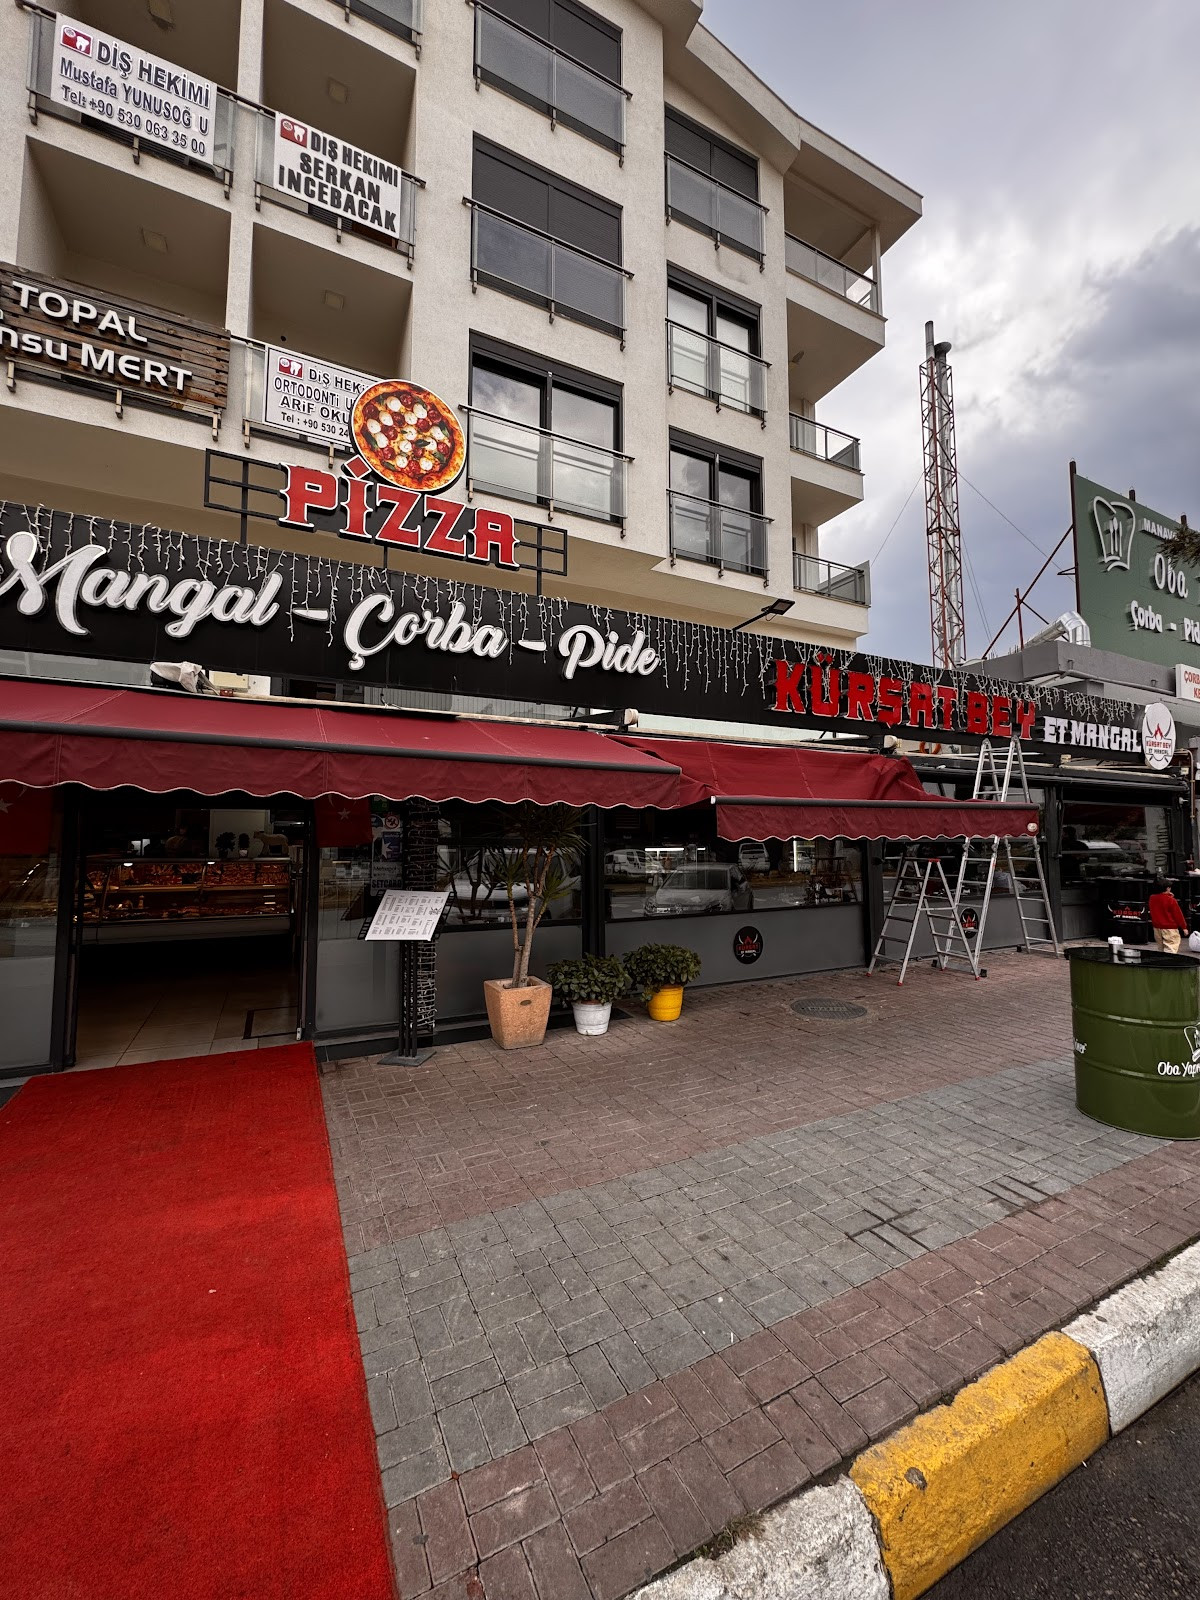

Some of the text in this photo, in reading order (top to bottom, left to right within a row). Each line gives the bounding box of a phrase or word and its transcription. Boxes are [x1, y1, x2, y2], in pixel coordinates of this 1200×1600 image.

[60, 57, 117, 97] Mustafa
[97, 41, 210, 108] DİŞ HEKİMİ
[61, 84, 205, 154] Tel: +90 530 063 35 00
[300, 152, 381, 204] SERKAN
[12, 280, 148, 343] TOPAL
[81, 342, 193, 391] MERT
[281, 411, 294, 423] Tel
[303, 418, 318, 430] +90
[321, 423, 336, 434] 530
[0, 530, 284, 638] Mangal
[343, 592, 510, 671] Çorba
[558, 624, 661, 680] Pide
[1130, 599, 1163, 633] Çorba
[967, 691, 1036, 740] BEY
[1043, 715, 1142, 753] ET MANGAL
[1157, 1061, 1182, 1076] Oba
